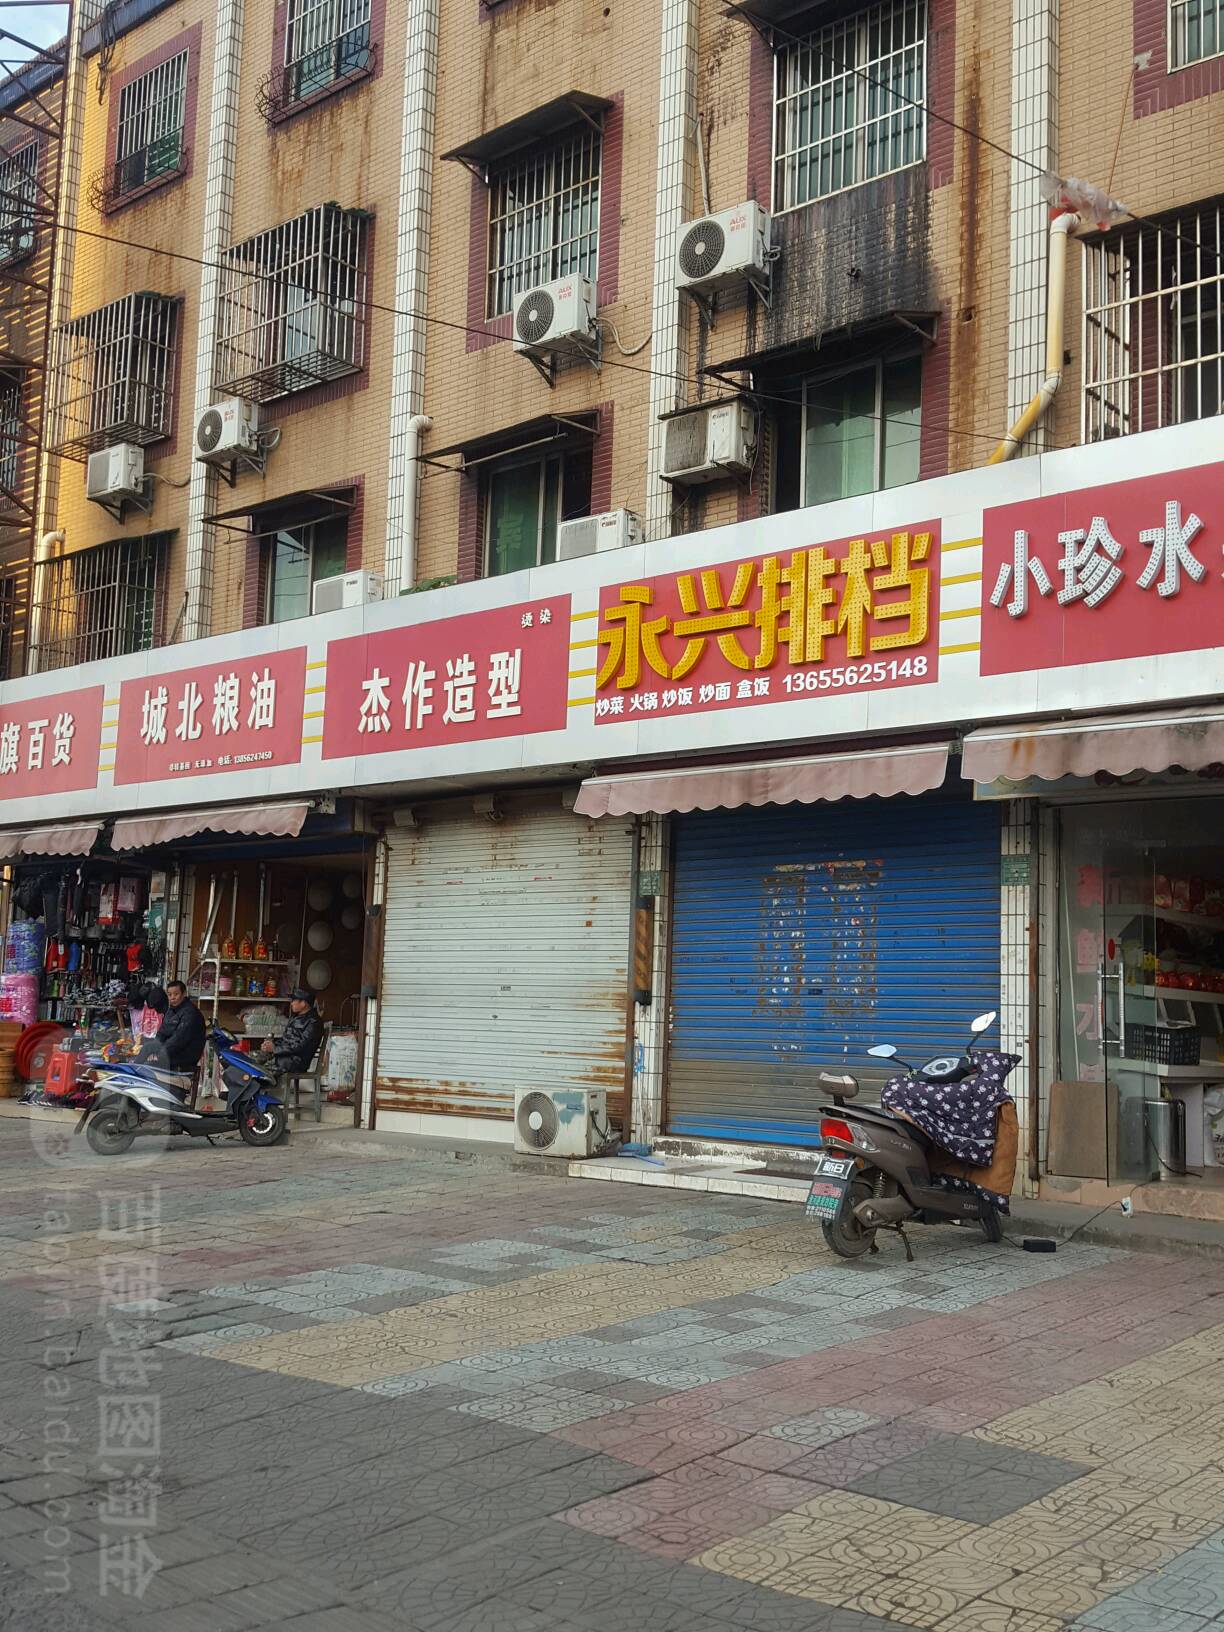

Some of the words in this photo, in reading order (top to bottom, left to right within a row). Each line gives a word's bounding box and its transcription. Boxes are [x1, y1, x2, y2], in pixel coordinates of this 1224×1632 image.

[989, 500, 1224, 618] 小珍水
[521, 608, 552, 628] 烫染
[596, 531, 934, 690] 永兴排档
[140, 667, 277, 745] 城北粮油
[358, 648, 523, 733] 杰作造型
[595, 696, 624, 717] 炒菜
[629, 692, 658, 712] 火锅
[661, 687, 693, 708] 炒饭
[698, 682, 732, 703] 炒面
[736, 677, 771, 698] 盒饭
[782, 655, 928, 693] 13655625148
[0, 712, 75, 775] 旗百货
